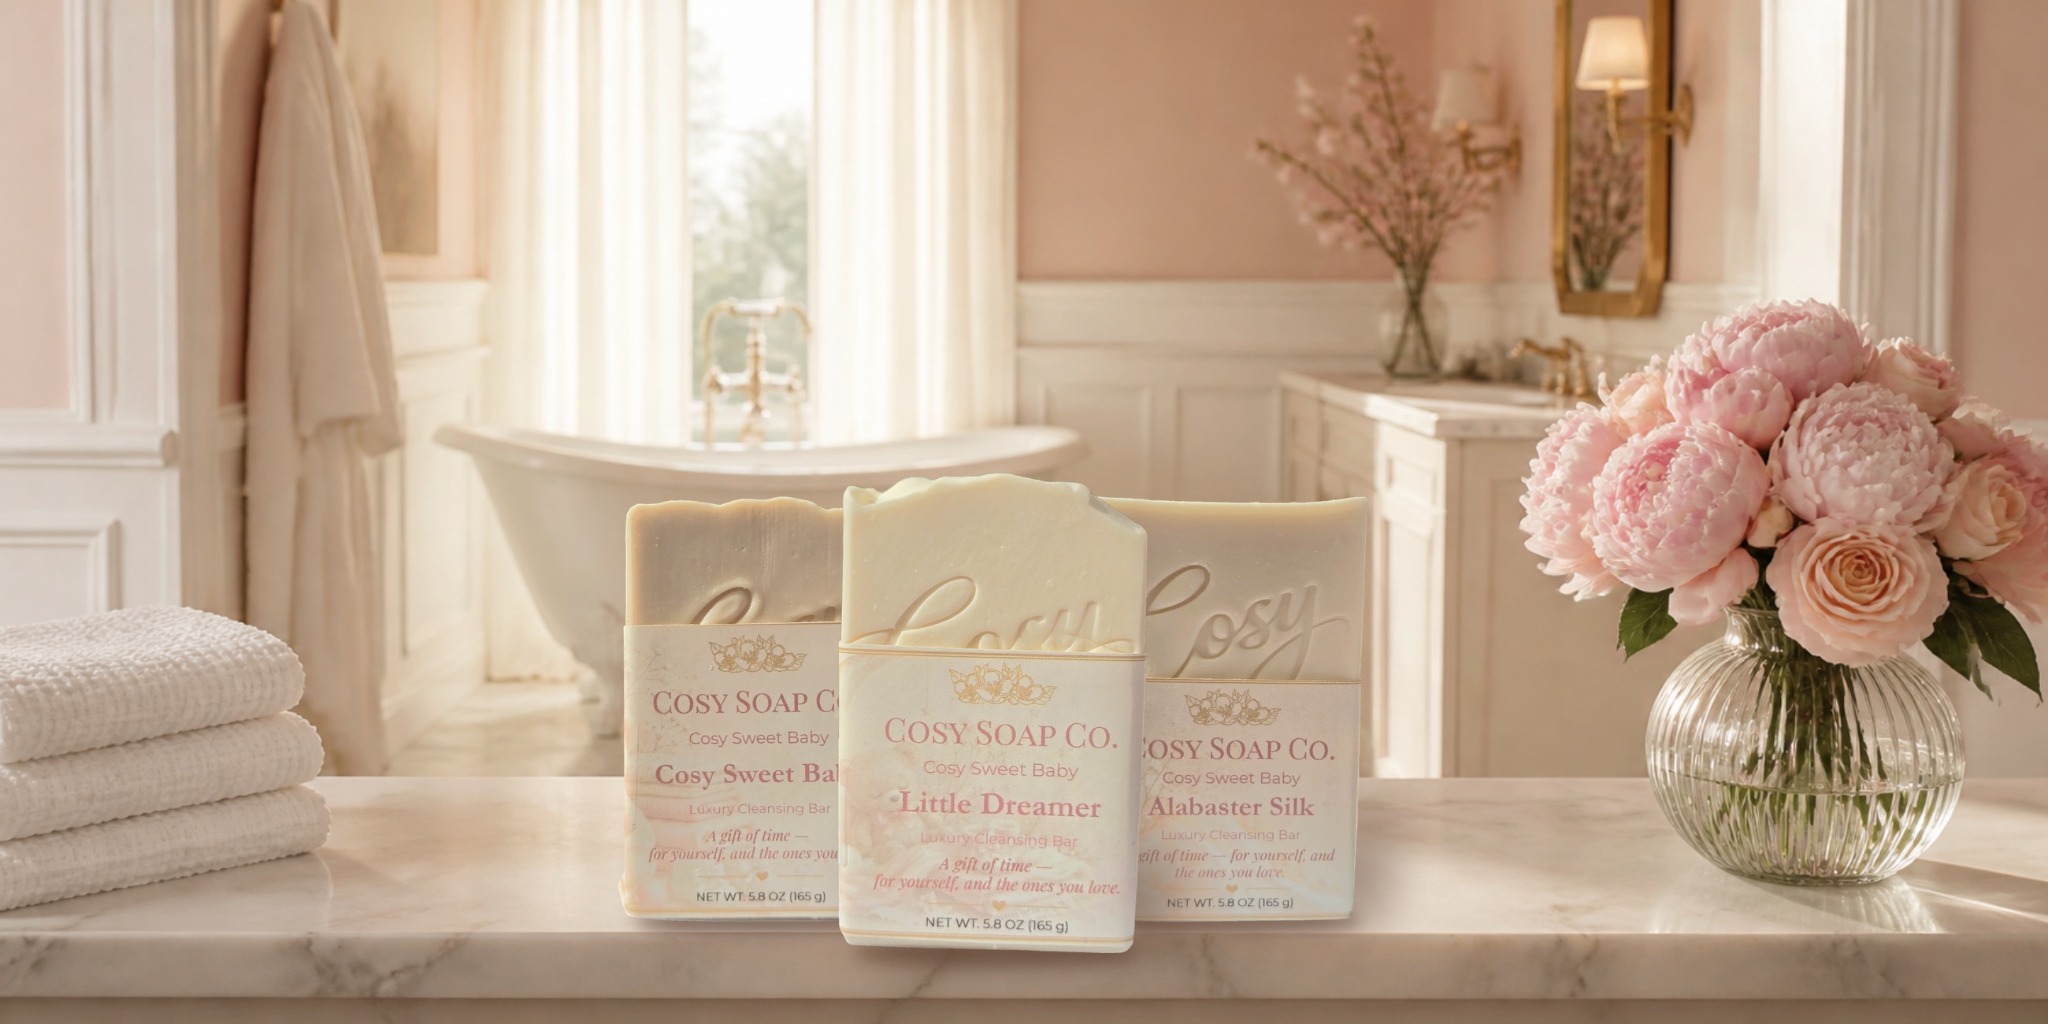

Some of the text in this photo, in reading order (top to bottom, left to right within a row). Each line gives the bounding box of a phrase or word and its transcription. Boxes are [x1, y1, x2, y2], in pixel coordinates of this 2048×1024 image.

[816, 688, 839, 713] C
[689, 730, 829, 747] Cosy Sweet Baby
[1143, 737, 1202, 760] OSY
[655, 763, 839, 790] Cosy Sweet Ba
[923, 760, 1079, 781] Cosy Sweet Baby
[1162, 771, 1300, 787] Cosy Sweet Baby
[690, 803, 831, 816] Luxury Cleansing Bar
[899, 790, 1101, 818] Little Dreamer
[1148, 796, 1315, 816] Alabaster Silk
[706, 831, 716, 842] A
[719, 829, 742, 844] gift
[746, 829, 762, 844] of
[762, 829, 791, 842] time
[920, 831, 1078, 849] Luxury Cleansing Bar
[1161, 829, 1301, 842] Luxury Cleansing Bar
[648, 847, 838, 863] for yourself, and the ones you
[1138, 849, 1160, 864] gift
[1163, 849, 1179, 864] of
[1180, 849, 1209, 861] time
[1230, 849, 1250, 864] for
[1252, 849, 1306, 864] yourself,
[1310, 849, 1336, 861] and
[938, 859, 950, 871] A
[953, 857, 978, 874] gift
[982, 858, 1000, 874] of
[1000, 859, 1033, 873] time
[1175, 866, 1285, 880] the ones you love.
[873, 874, 1121, 896] for yourself, and the ones you love.
[697, 891, 826, 903] NET WT. 5.8 OZ (165 g)
[1167, 897, 1294, 909] NET WT. 5.8 OZ (165 g)
[926, 917, 1069, 934] NET WT. 5.8 OZ (165 g)
